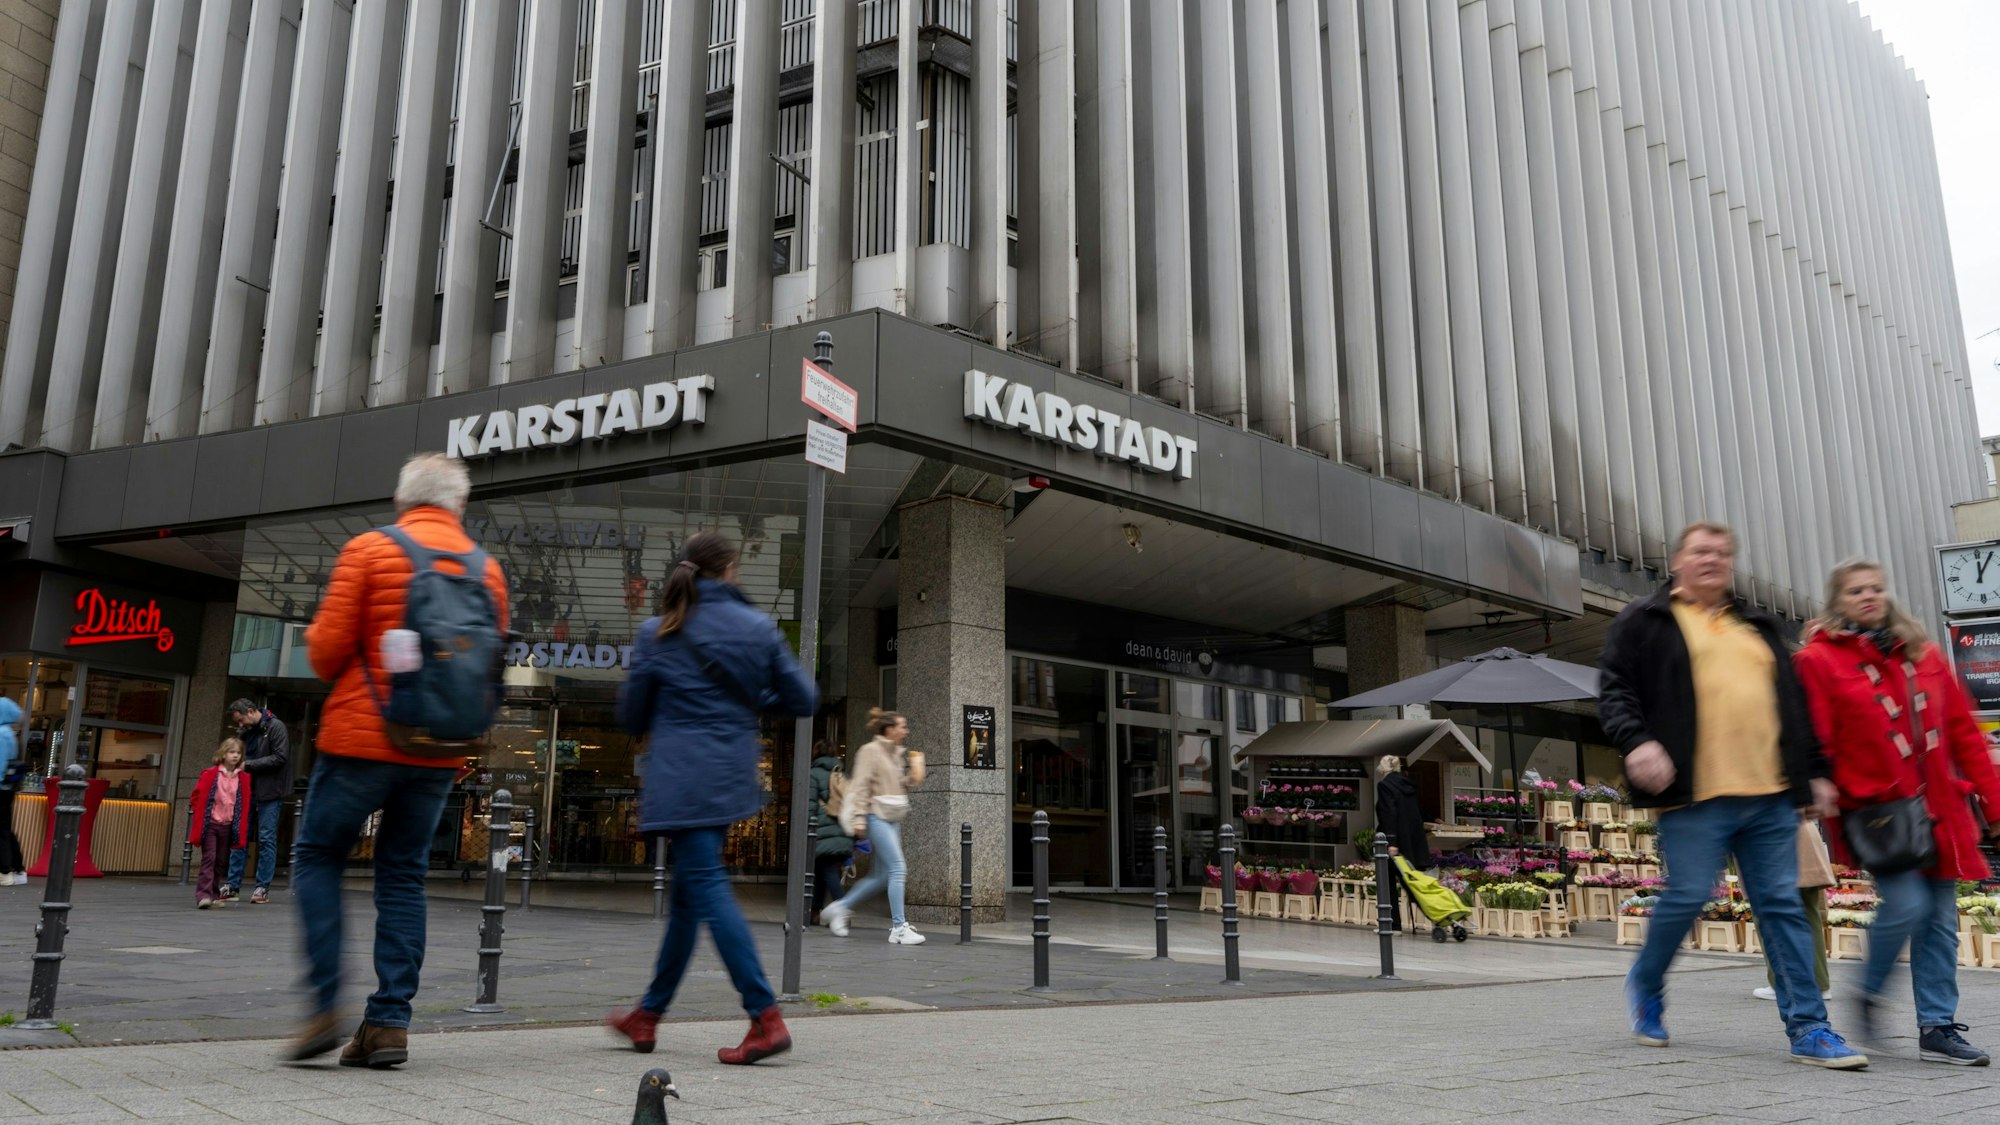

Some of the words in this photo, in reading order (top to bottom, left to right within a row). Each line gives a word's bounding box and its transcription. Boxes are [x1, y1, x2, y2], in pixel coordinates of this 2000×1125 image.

[806, 368, 855, 410] Feuerwehrzufahrt
[817, 391, 844, 416] freihalten
[446, 373, 715, 459] KARSTADT
[964, 369, 1197, 480] KARSTADT
[72, 588, 161, 634] Ditsch
[505, 641, 634, 669] RSTADT
[1125, 639, 1153, 658] dean
[1154, 647, 1162, 660] &
[1163, 646, 1192, 665] david
[505, 773, 527, 782] BOSS
